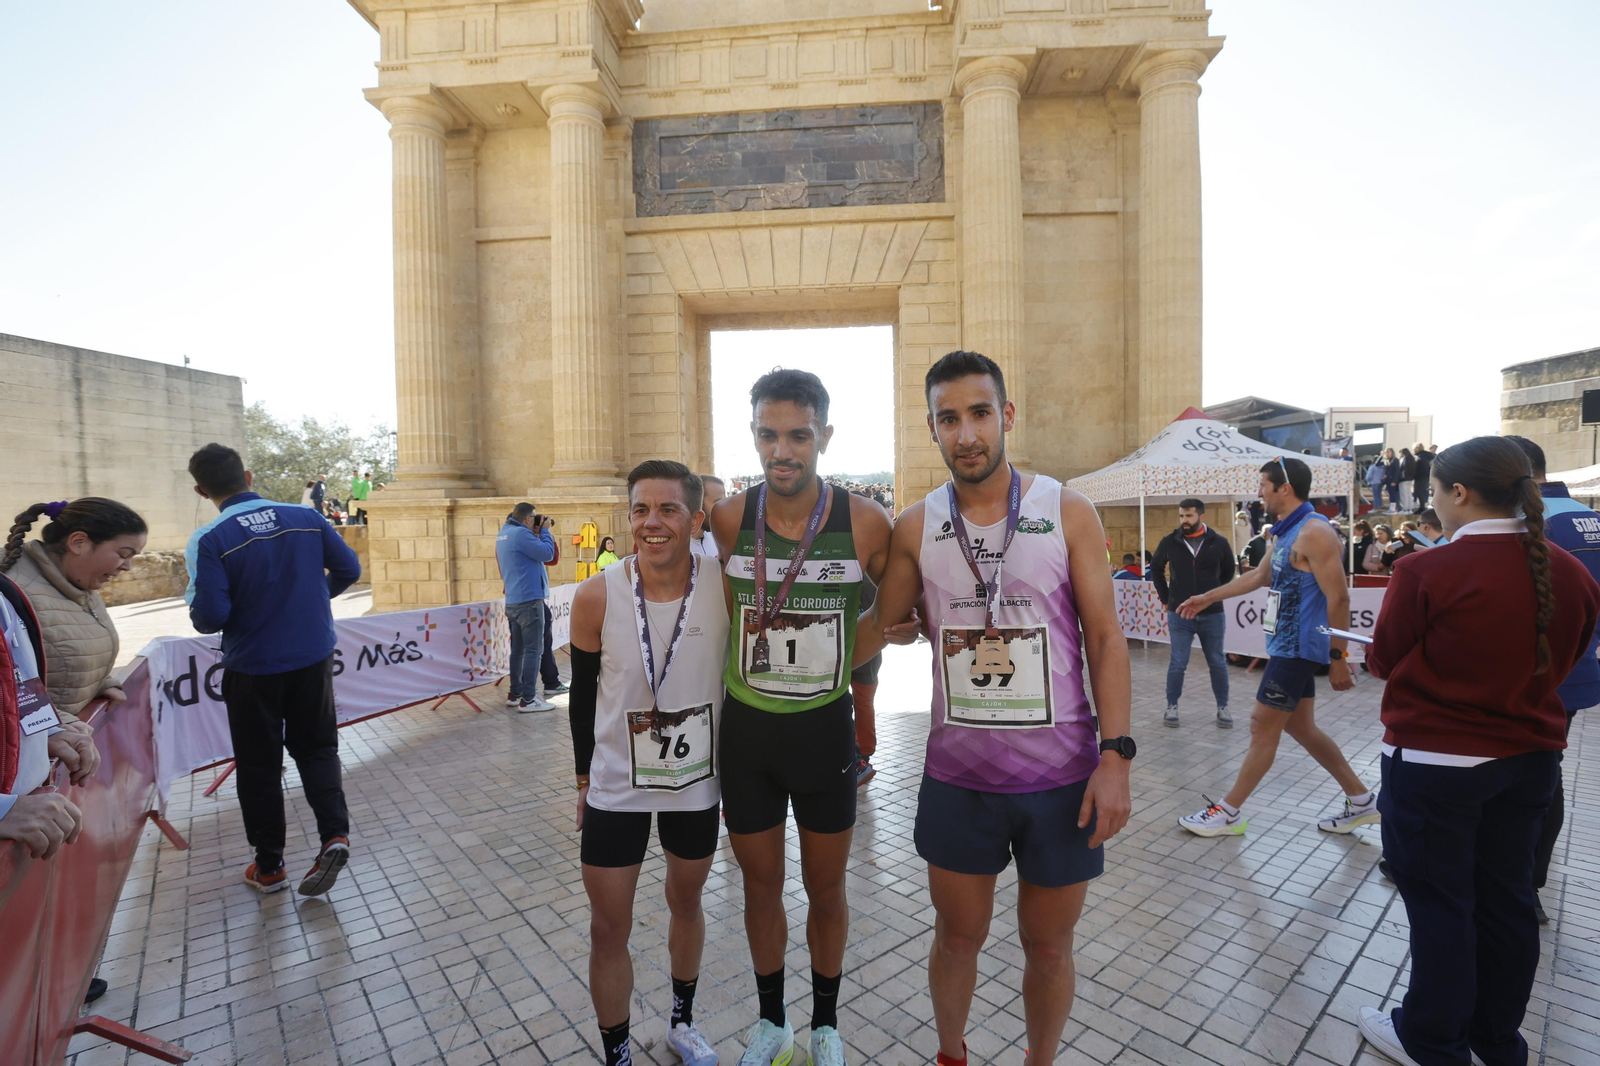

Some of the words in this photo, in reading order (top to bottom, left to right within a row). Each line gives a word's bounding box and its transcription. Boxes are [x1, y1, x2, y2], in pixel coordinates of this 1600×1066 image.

[1012, 485, 1020, 511] CORDOBA
[236, 508, 276, 527] STAFF
[810, 514, 819, 531] MEDIA
[961, 535, 973, 563] CORDOBA
[770, 603, 781, 619] MEDIA
[791, 547, 806, 575] CORDOBA
[793, 595, 847, 609] CORDOBÉS
[950, 599, 986, 610] DIPUTACIÓN
[999, 599, 1033, 607] ALBACETE
[1350, 610, 1374, 628] ES
[786, 639, 796, 665] 1
[27, 716, 52, 728] PRENSA
[658, 733, 691, 760] 76
